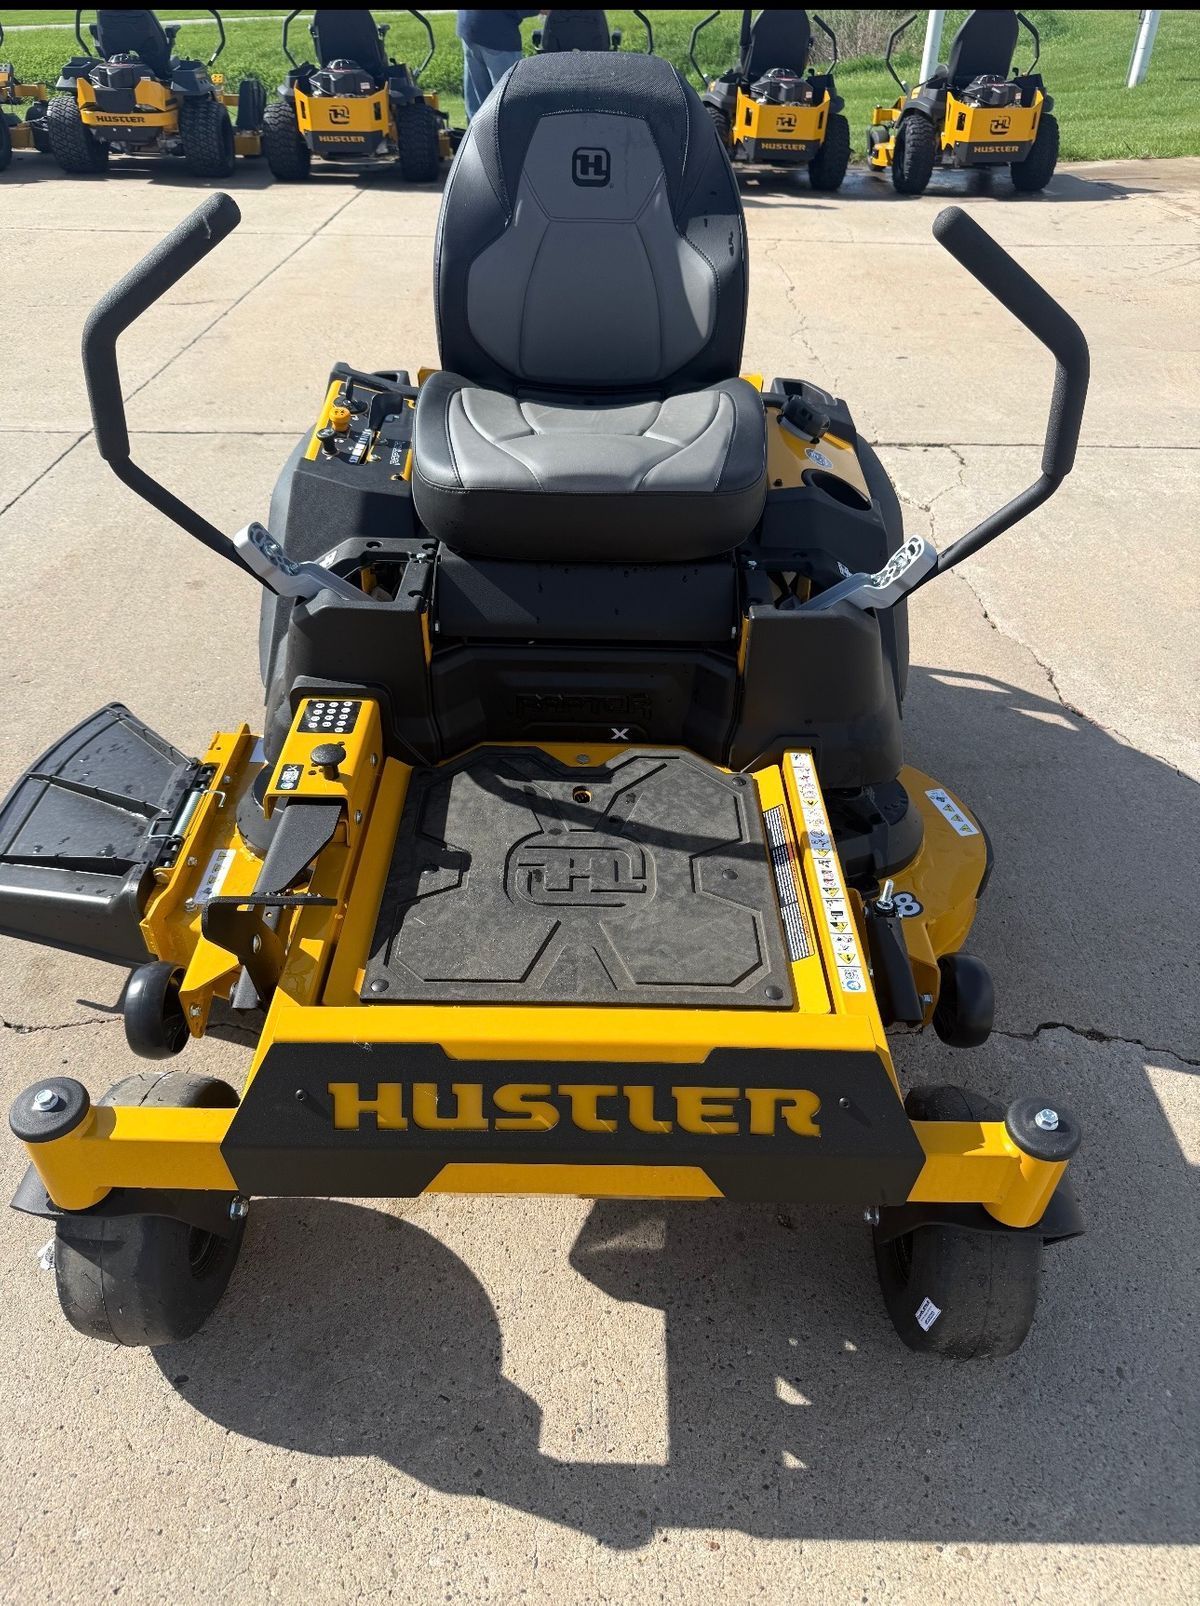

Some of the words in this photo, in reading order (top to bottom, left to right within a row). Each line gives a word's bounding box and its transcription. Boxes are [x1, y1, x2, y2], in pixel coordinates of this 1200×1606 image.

[95, 115, 145, 123] HUSTLER
[318, 135, 366, 143] HUSTLER
[761, 143, 807, 151] HUSTLER
[973, 145, 1020, 153] HUSTLER
[611, 728, 630, 740] X
[327, 1082, 822, 1138] HUSTLER
